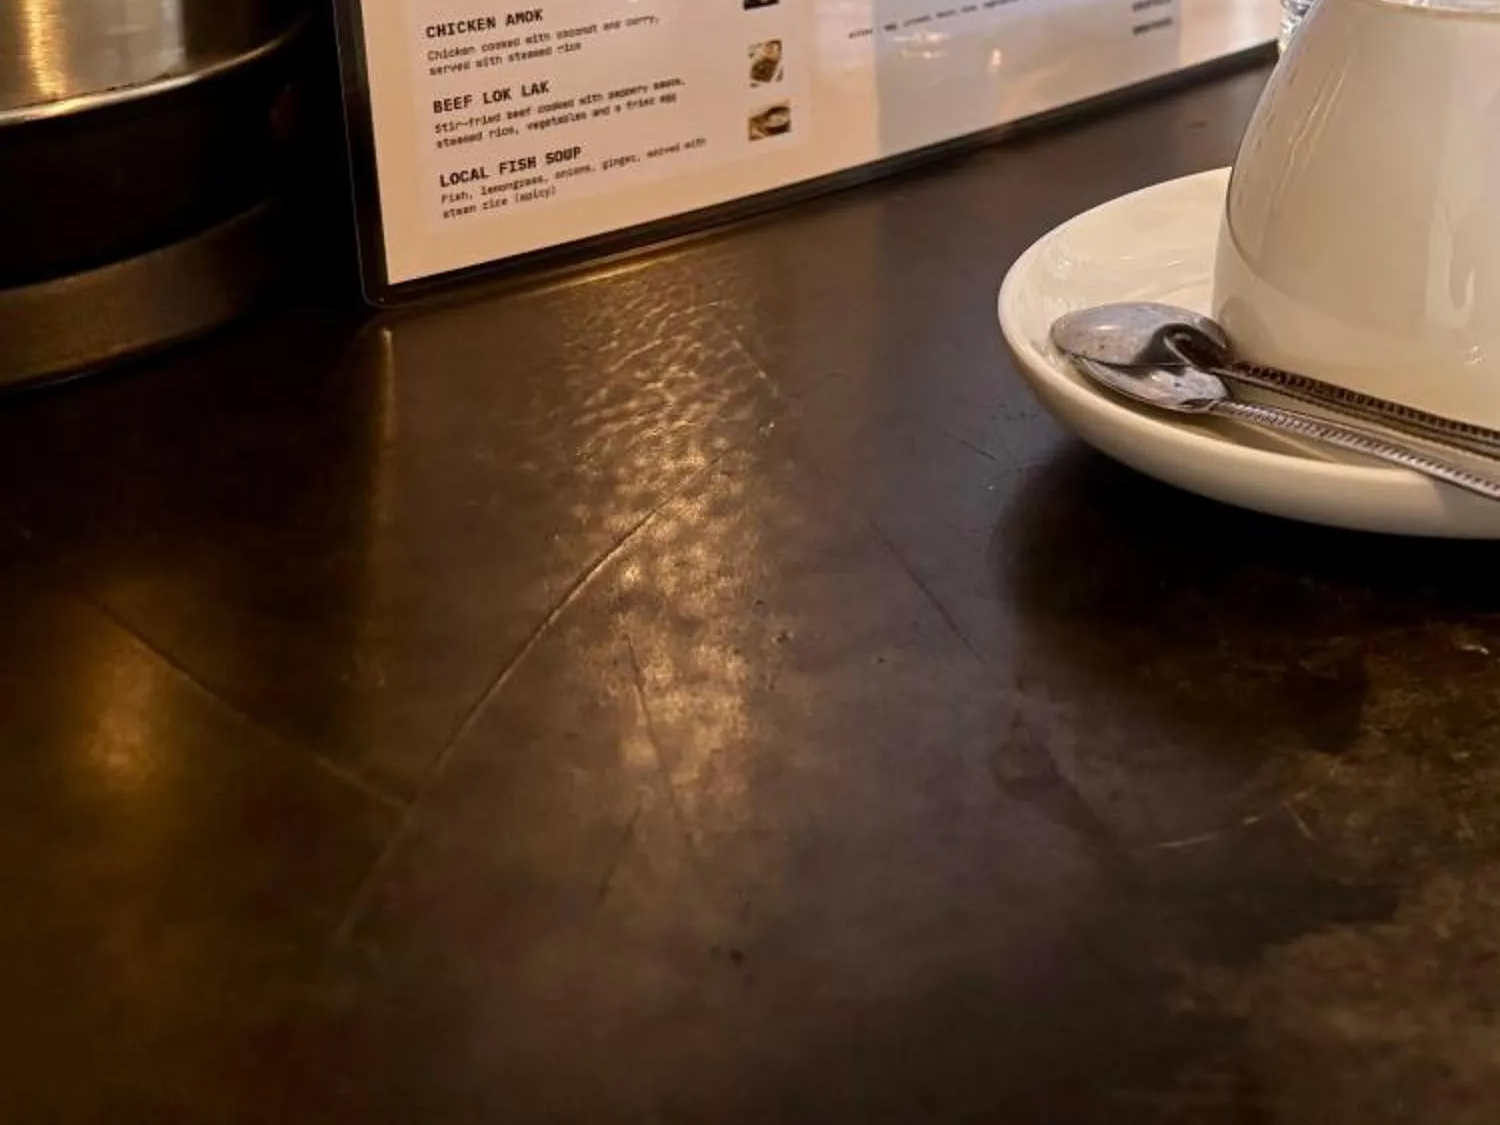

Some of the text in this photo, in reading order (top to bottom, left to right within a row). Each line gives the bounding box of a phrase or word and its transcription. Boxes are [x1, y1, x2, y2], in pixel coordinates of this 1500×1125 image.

[426, 9, 544, 39] CHICKEN AMOK
[429, 41, 581, 76] served with steamed rice
[434, 80, 549, 114] BEEF LOK LAK
[439, 146, 581, 188] LOCAL FISH SOUP
